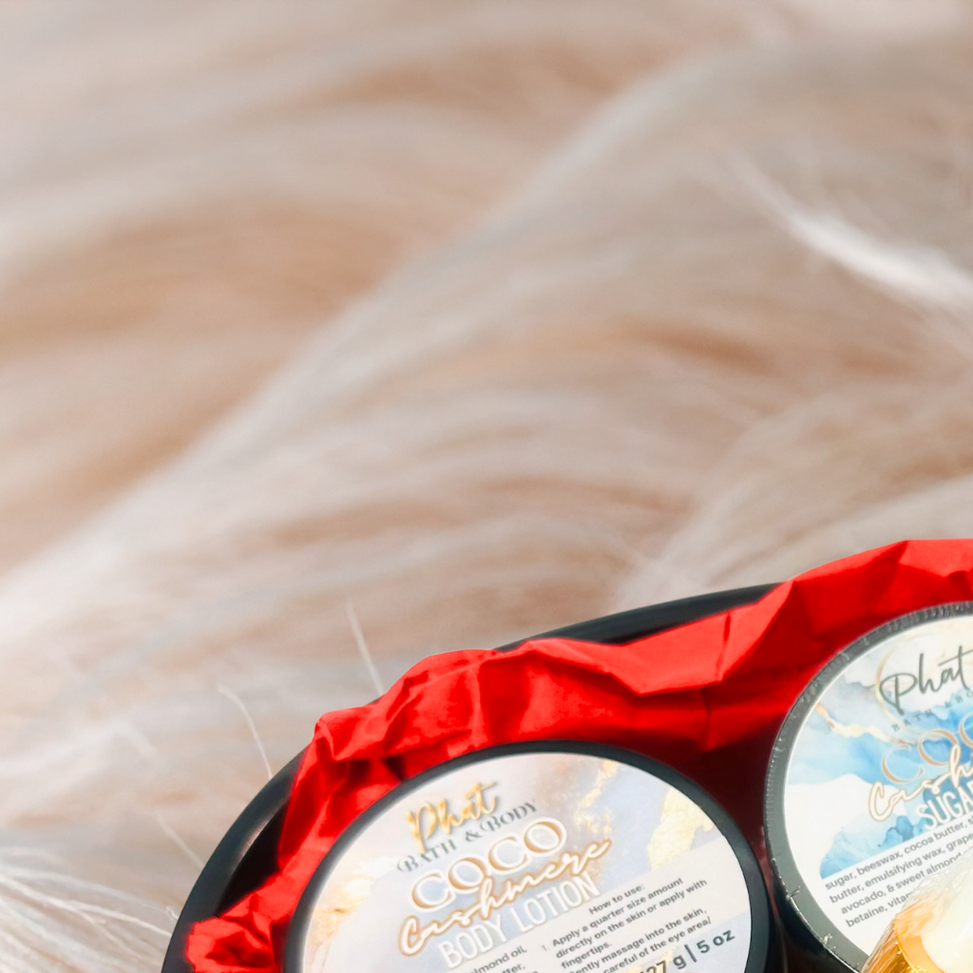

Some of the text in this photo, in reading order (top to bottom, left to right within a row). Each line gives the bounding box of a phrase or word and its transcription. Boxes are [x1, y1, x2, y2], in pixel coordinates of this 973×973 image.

[407, 782, 499, 853] Phat
[411, 818, 564, 911] COCO
[825, 872, 857, 890] sugar,
[856, 852, 904, 876] beeswax,
[904, 836, 934, 854] cocoa
[933, 822, 968, 840] butter,
[829, 885, 865, 904] butter,
[865, 857, 922, 887] emulsifying
[922, 848, 946, 861] wax,
[399, 840, 611, 955] Cashmere
[552, 929, 580, 947] Apply
[589, 907, 624, 928] quarter
[626, 897, 646, 910] size
[648, 878, 683, 899] amount
[556, 880, 707, 958] directly on the skin or apply with
[589, 884, 645, 915] How to use:
[841, 870, 925, 914] avocado, & sweet
[845, 905, 888, 927] betaine,
[438, 872, 601, 969] BODY LOTION
[601, 938, 645, 963] massage
[645, 928, 665, 941] into
[665, 919, 682, 930] the
[683, 908, 707, 922] skin,
[639, 947, 649, 958] of
[650, 941, 667, 952] the
[668, 931, 685, 943] eye
[510, 945, 528, 958] oil,
[561, 942, 612, 969] fingertips.
[673, 955, 687, 970] g
[696, 940, 710, 954] 5
[712, 930, 735, 946] oz
